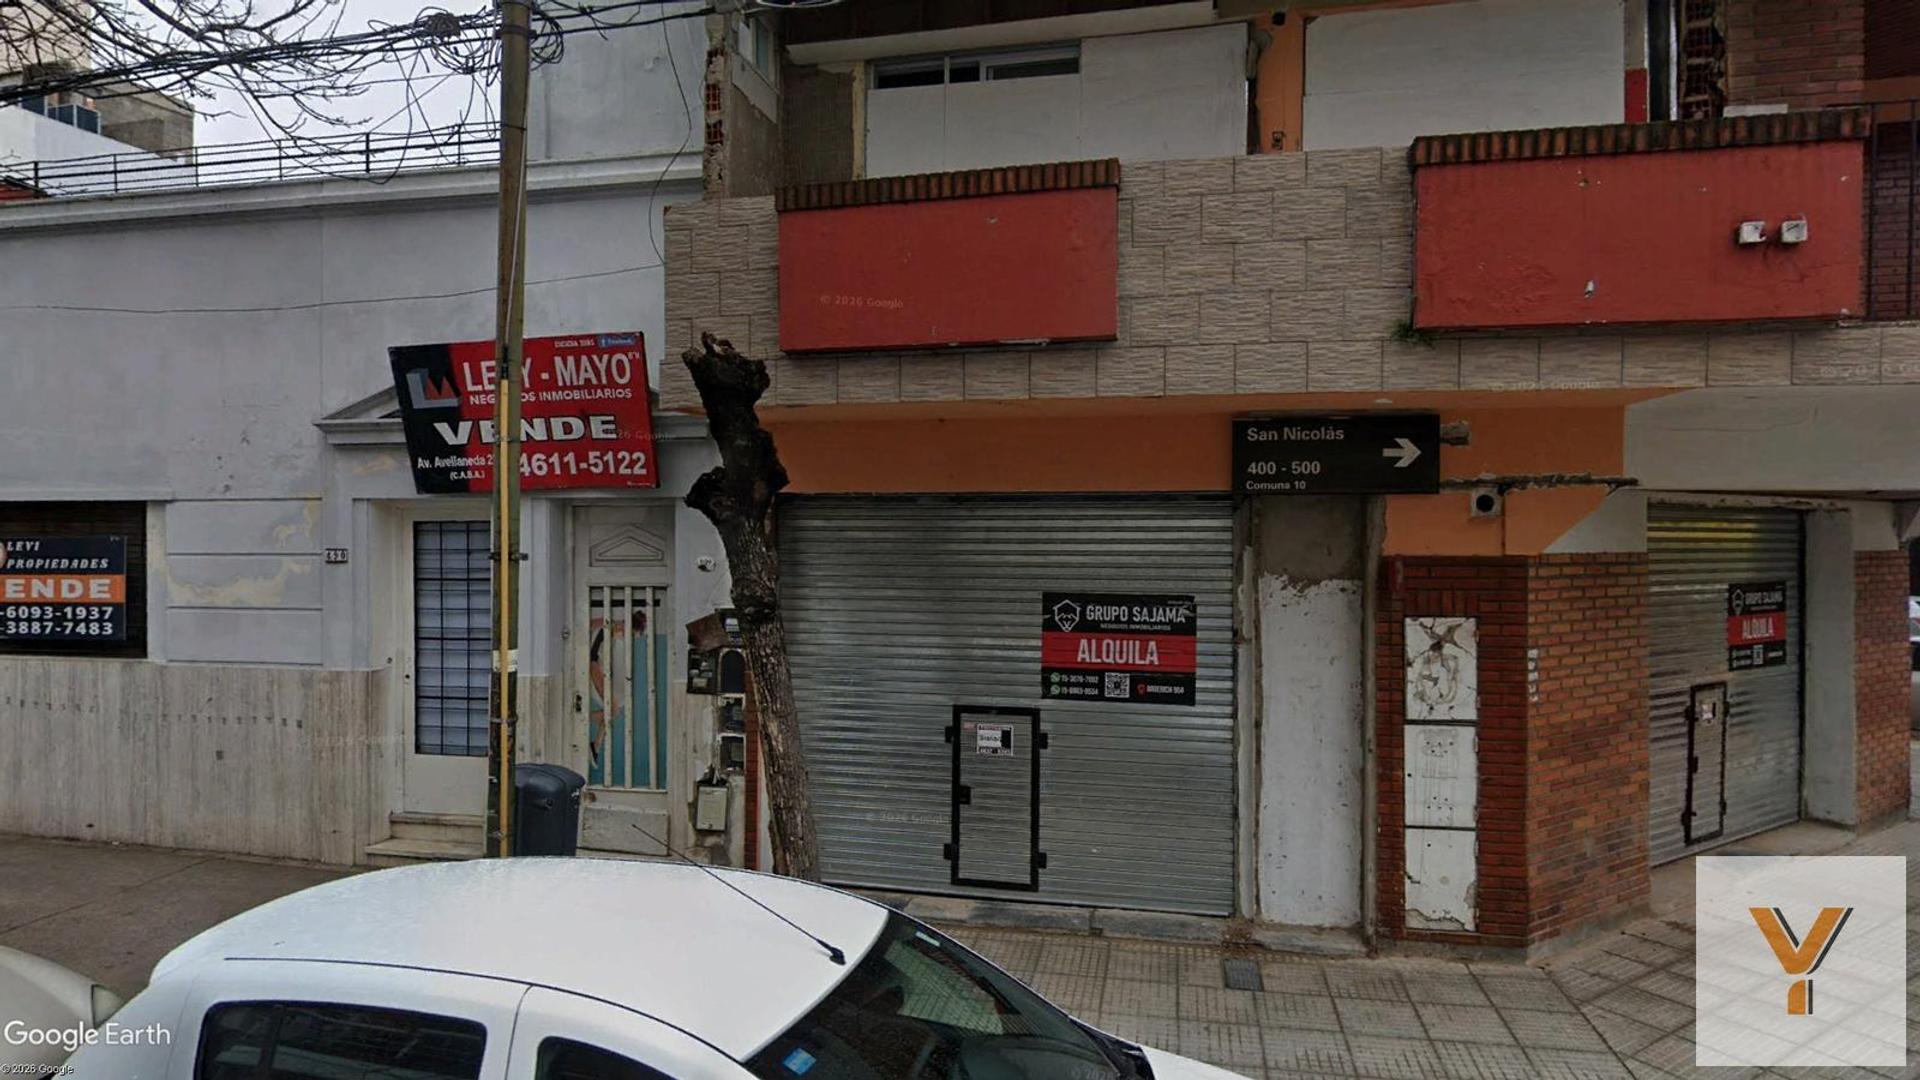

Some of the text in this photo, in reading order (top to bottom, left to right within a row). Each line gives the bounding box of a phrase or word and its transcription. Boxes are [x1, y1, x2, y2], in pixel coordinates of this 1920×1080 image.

[463, 357, 532, 392] LEY
[554, 353, 631, 387] MAYO
[470, 388, 632, 405] NEGOS INMOBILIARIOS
[434, 415, 617, 446] VENDE
[1247, 426, 1345, 441] San Nicolás
[417, 456, 432, 469] Av.
[434, 454, 486, 468] Avellaneda
[520, 451, 648, 476] 4611-5122
[1247, 461, 1277, 475] 400
[1291, 460, 1321, 474] 500
[1246, 480, 1306, 490] Comuna 10
[6, 541, 40, 551] LEVI
[6, 558, 109, 569] PROPIEDADES
[5, 578, 111, 598] ENDE
[1086, 605, 1186, 623] GRUPO SAJAMA
[1077, 638, 1159, 665] ALQUILA
